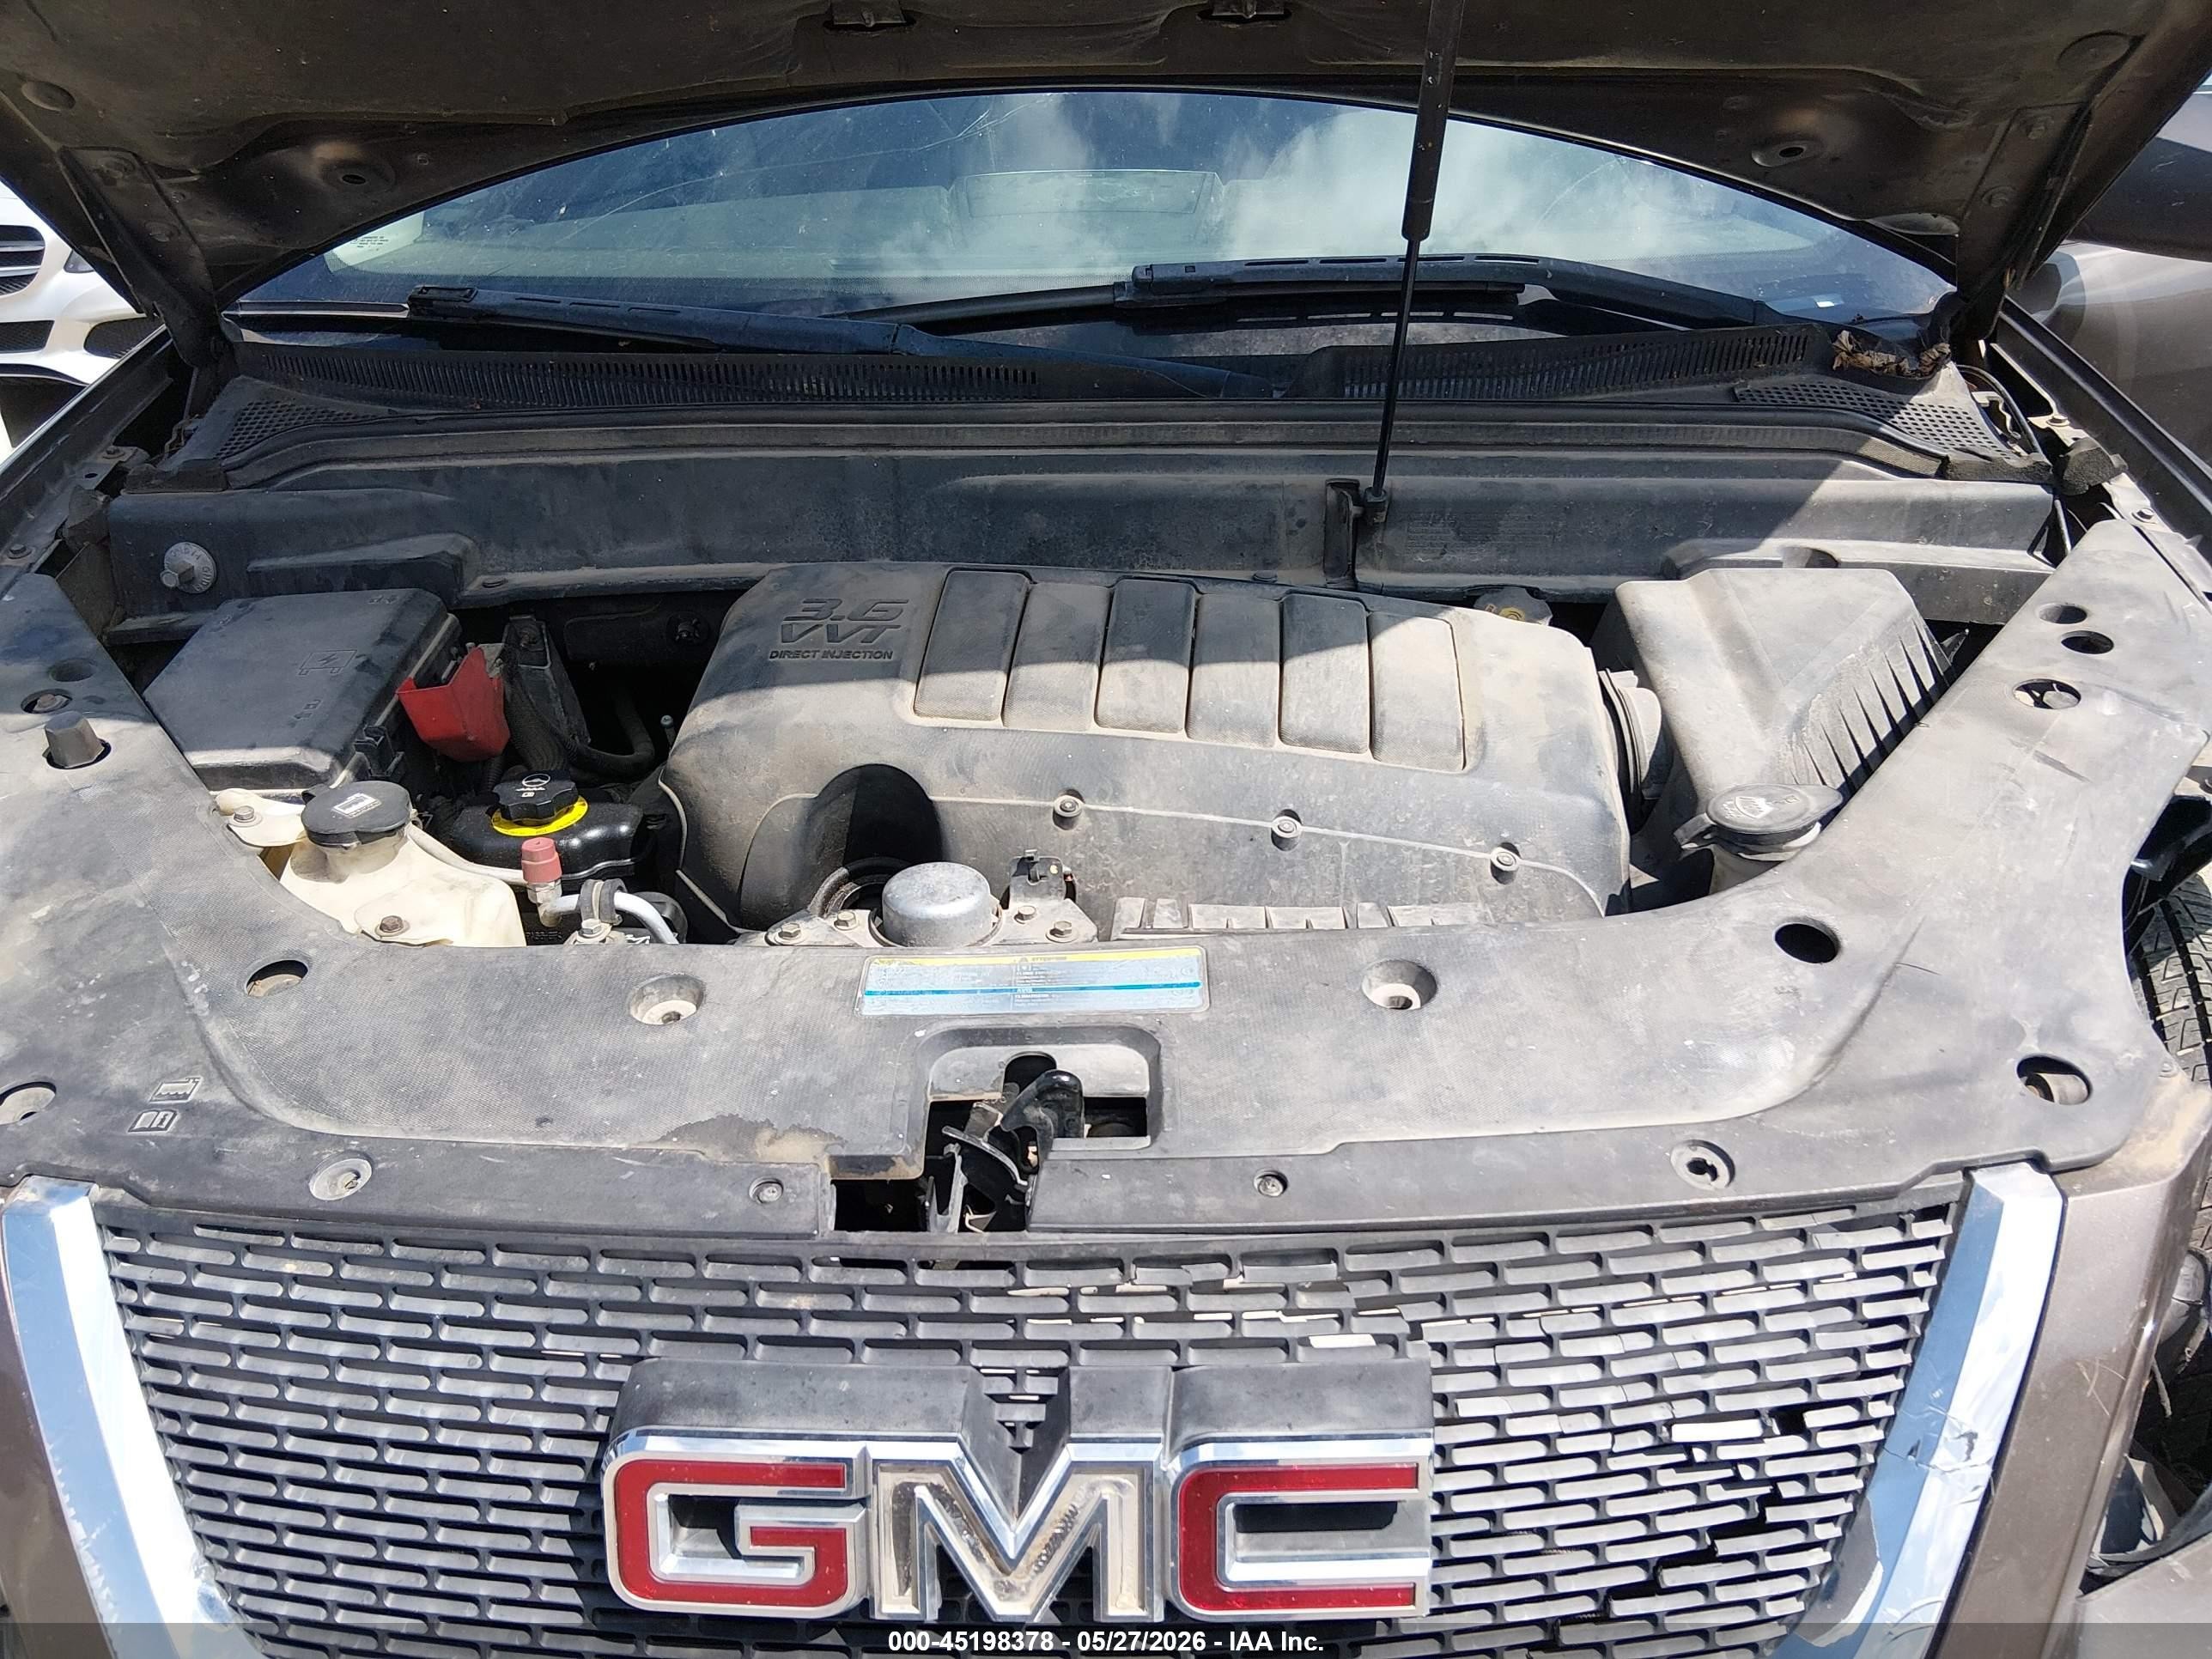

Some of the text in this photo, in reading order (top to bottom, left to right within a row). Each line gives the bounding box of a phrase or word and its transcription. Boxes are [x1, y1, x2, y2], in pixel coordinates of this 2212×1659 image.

[783, 599, 909, 621] 3.6
[781, 623, 902, 643] VVT
[769, 650, 894, 659] DIRECT INJECTION
[602, 1427, 1432, 1622] GMC
